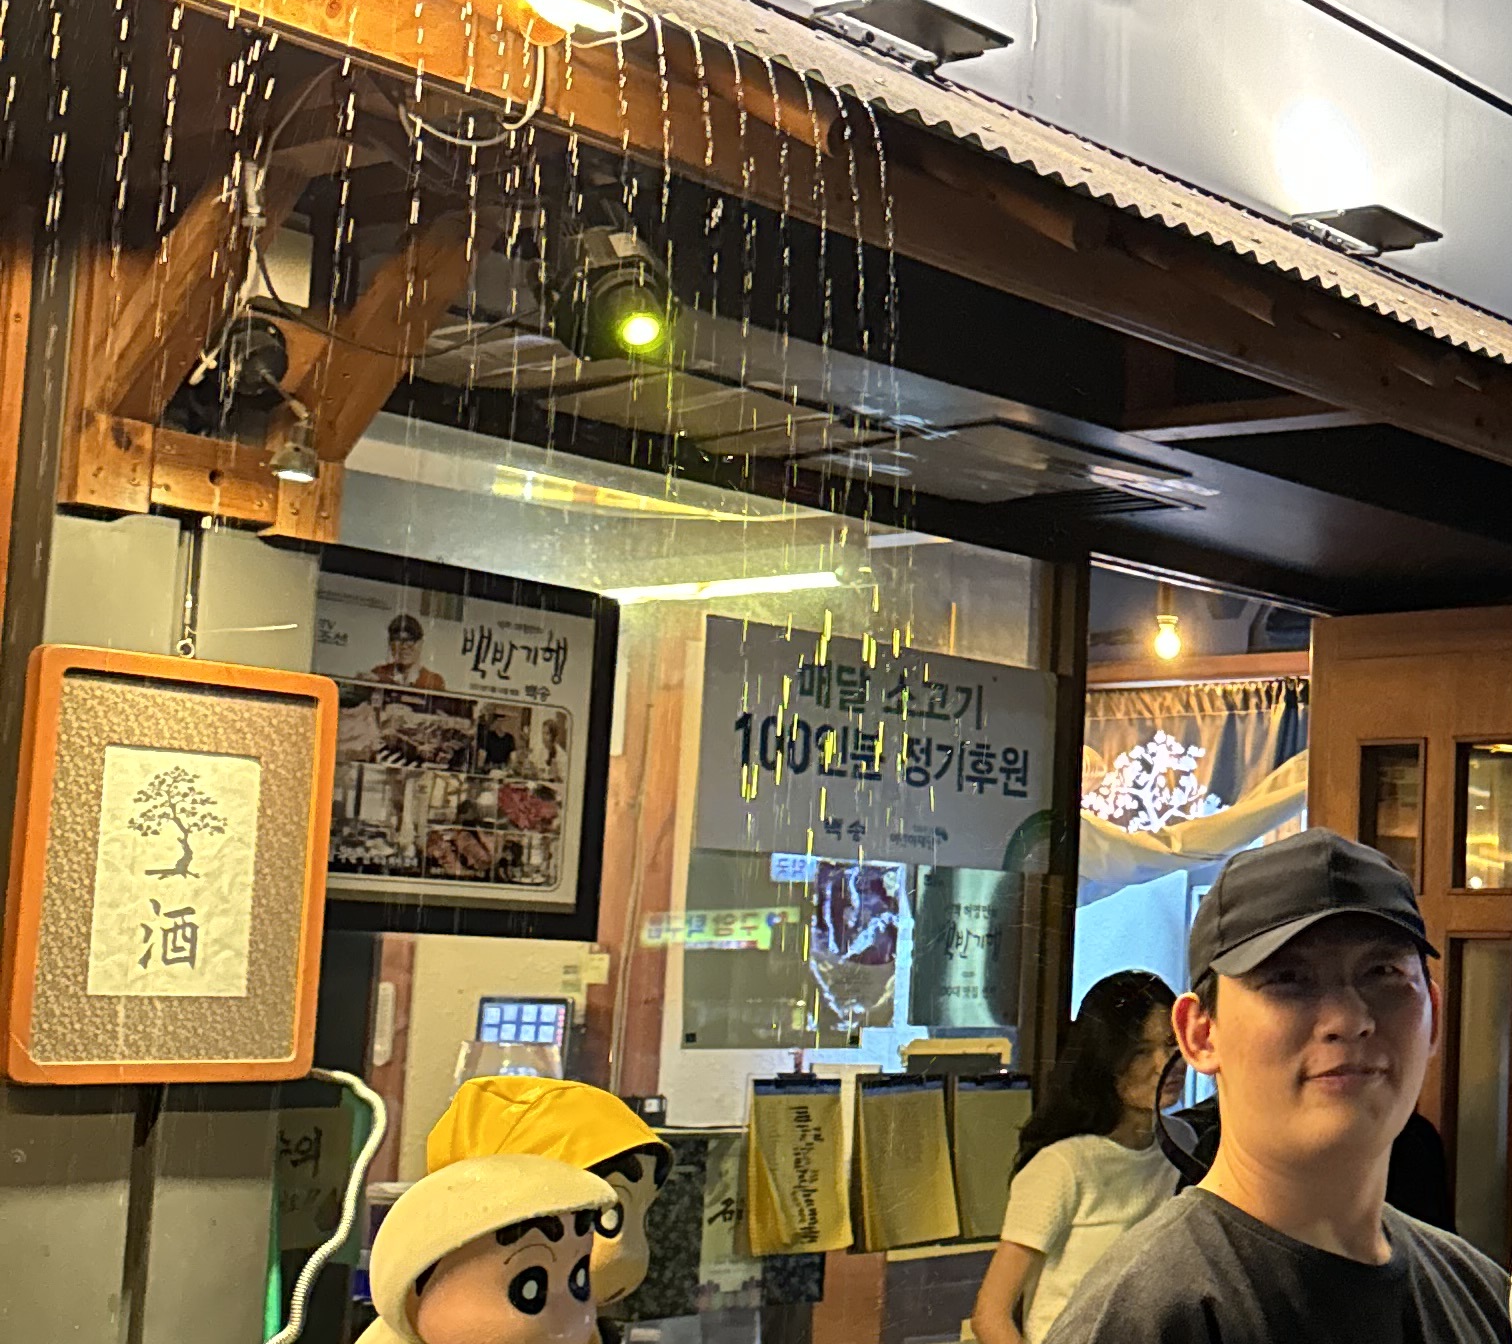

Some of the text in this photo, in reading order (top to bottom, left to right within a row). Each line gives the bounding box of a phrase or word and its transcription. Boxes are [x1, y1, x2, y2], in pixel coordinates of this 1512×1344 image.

[461, 624, 568, 685] 백반기행
[883, 674, 983, 730] 소고기
[905, 736, 1029, 798] 정기후원
[138, 898, 199, 970] 酒
